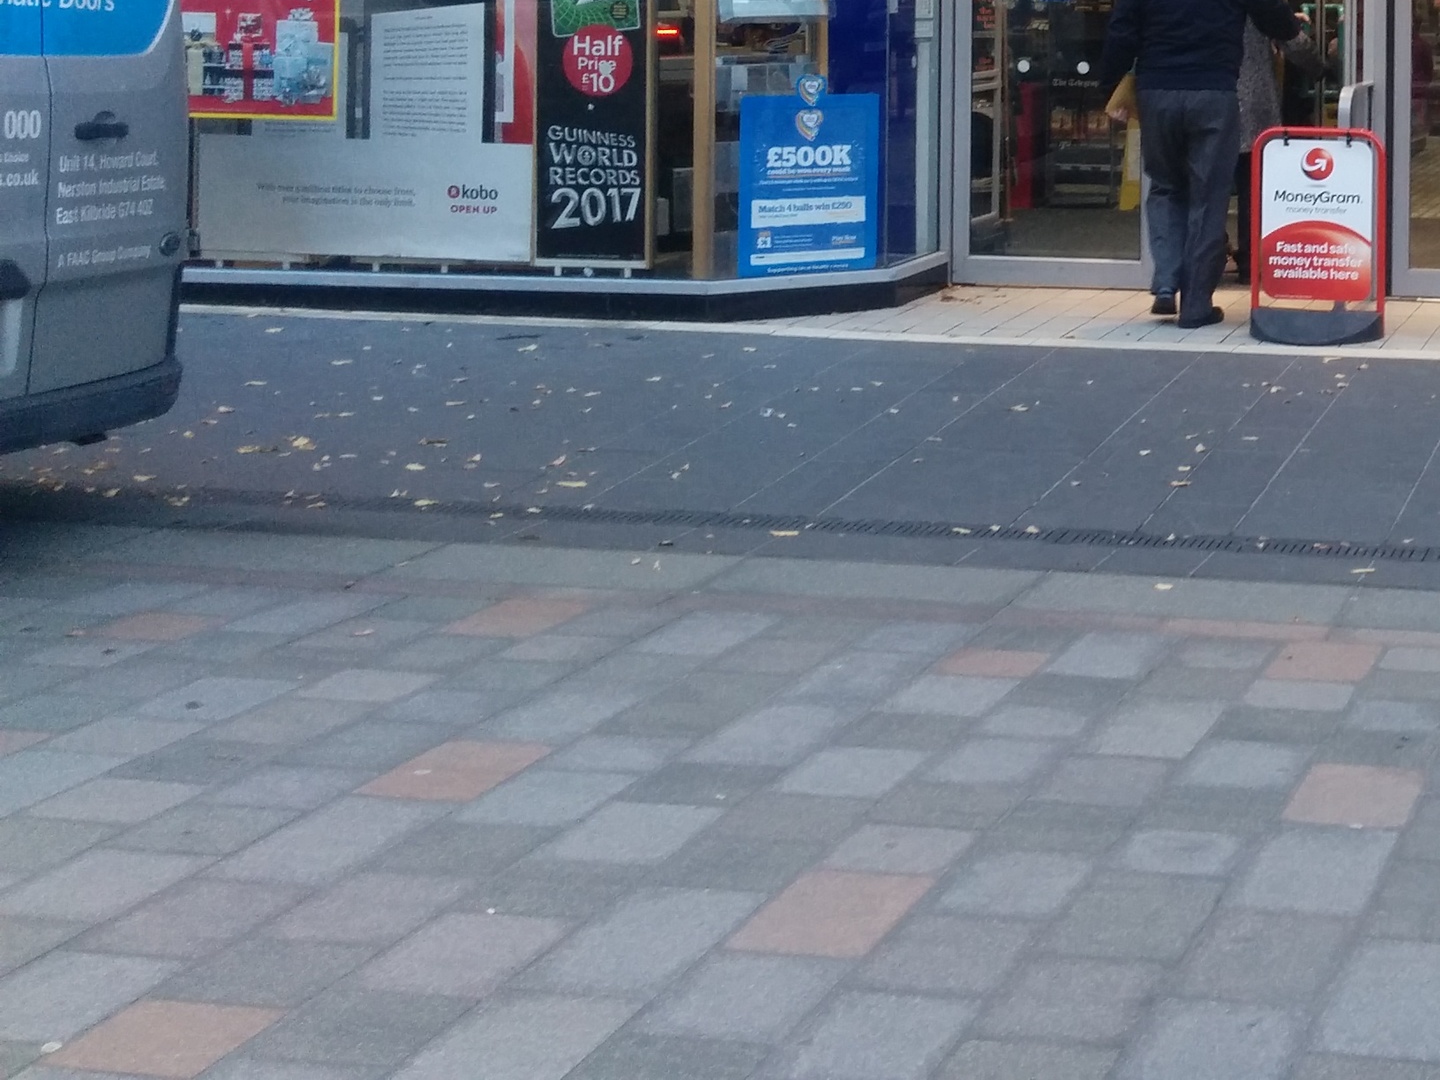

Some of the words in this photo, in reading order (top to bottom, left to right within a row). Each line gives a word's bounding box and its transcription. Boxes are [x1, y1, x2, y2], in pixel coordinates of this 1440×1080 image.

[573, 35, 623, 56] Half
[581, 73, 615, 93] £10
[4, 110, 42, 139] 000
[547, 125, 636, 148] GUINNESS
[59, 155, 80, 173] Unit
[548, 142, 638, 167] WORLD
[766, 143, 852, 169] £500K
[549, 166, 641, 186] RECORDS
[461, 184, 499, 200] kobo
[1273, 189, 1361, 206] MoneyGram
[56, 206, 79, 225] East
[450, 205, 481, 214] OPEN
[482, 205, 498, 215] UP
[551, 186, 642, 230] 2017
[758, 204, 786, 214] Match
[786, 204, 793, 212] 4
[815, 202, 831, 211] win
[1275, 241, 1304, 254] Fast
[1304, 242, 1328, 254] and
[1329, 243, 1357, 255] safe
[1268, 255, 1312, 269] money
[1312, 255, 1364, 268] transfer
[1272, 267, 1328, 280] available
[1329, 268, 1359, 281] here
